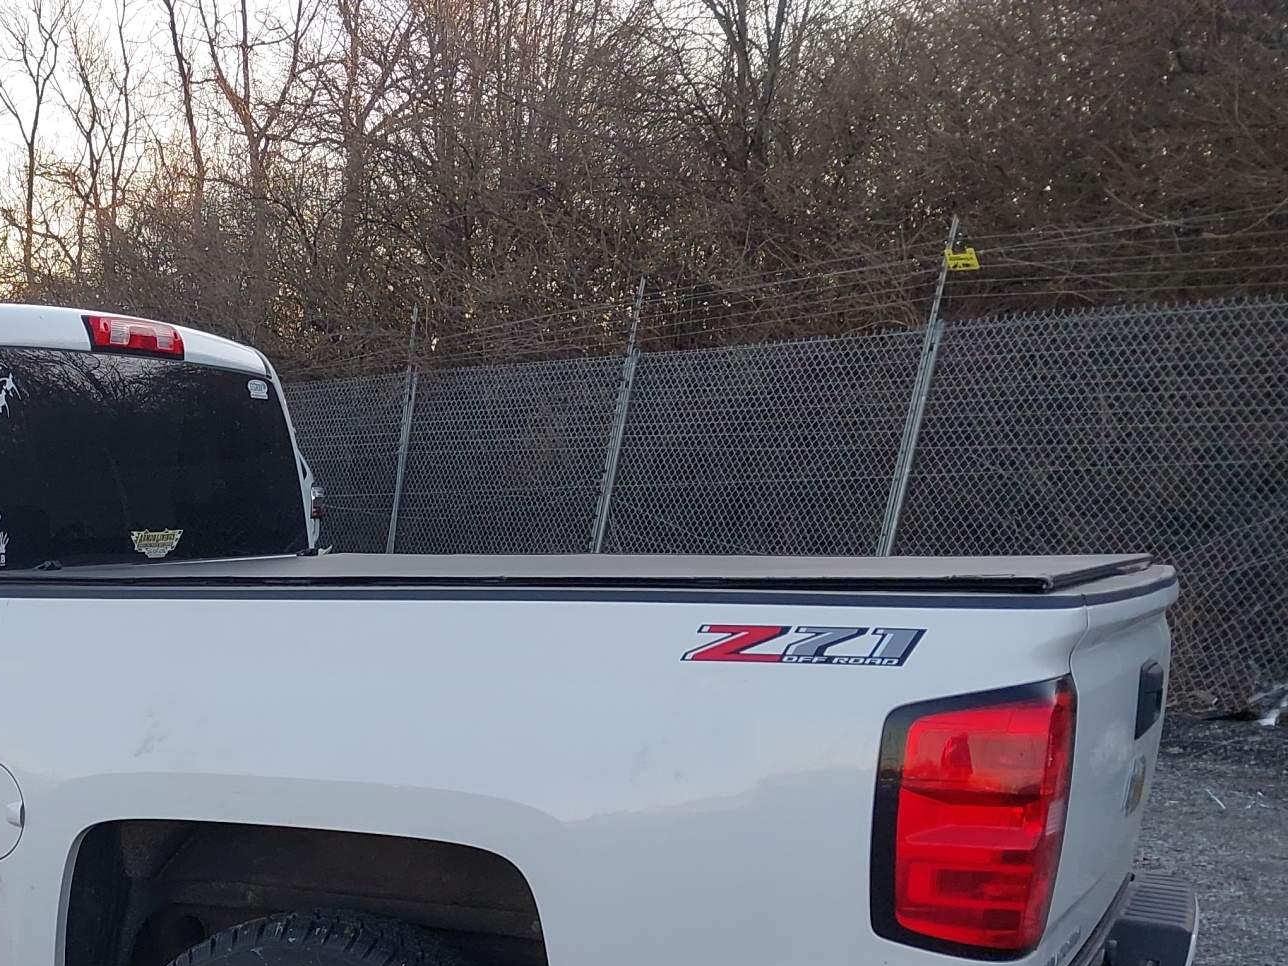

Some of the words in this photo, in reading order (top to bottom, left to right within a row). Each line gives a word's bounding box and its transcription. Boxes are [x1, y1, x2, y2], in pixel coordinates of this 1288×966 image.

[680, 623, 928, 667] Z71
[782, 655, 828, 665] OFF
[832, 656, 900, 666] ROAD
